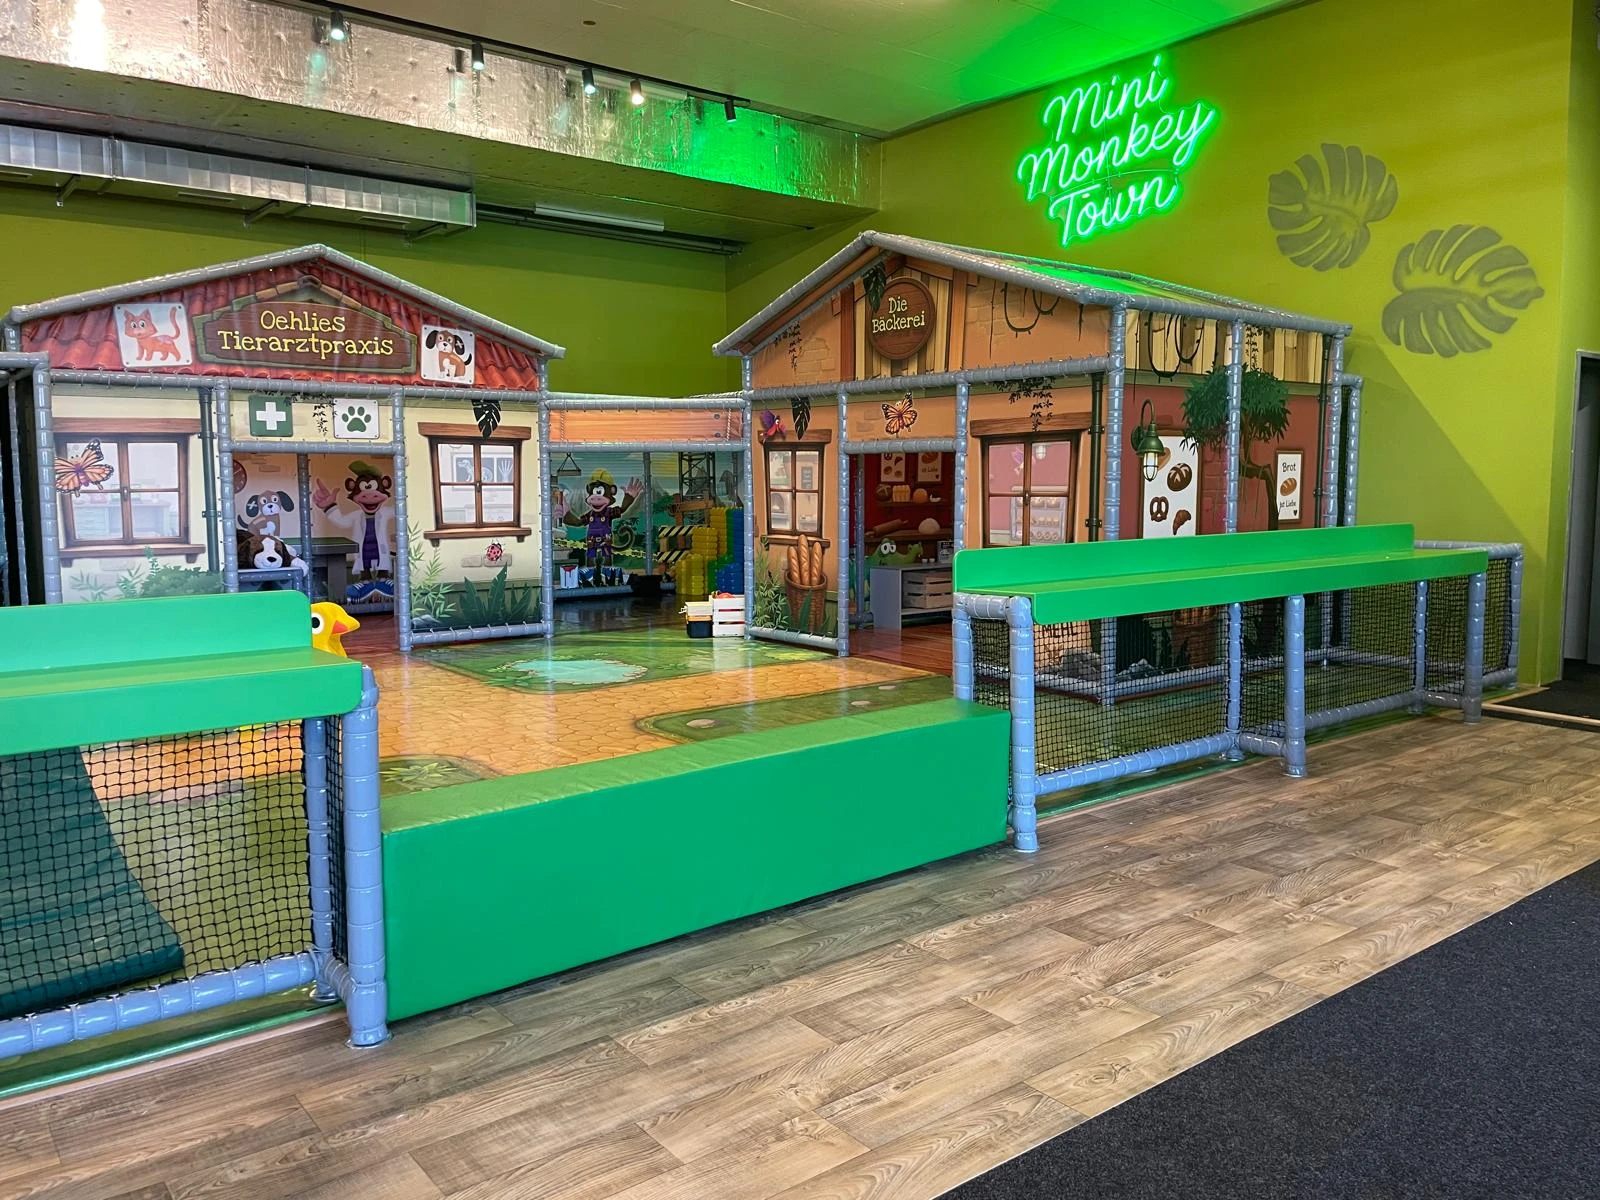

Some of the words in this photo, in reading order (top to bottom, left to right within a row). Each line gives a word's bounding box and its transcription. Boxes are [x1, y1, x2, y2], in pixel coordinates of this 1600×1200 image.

[1043, 54, 1168, 142] Mini
[1017, 103, 1215, 201] Monkey
[1050, 176, 1178, 245] Town
[888, 296, 908, 314] Die
[260, 310, 346, 332] Oehlies
[872, 310, 925, 333] Bäckerei
[217, 330, 394, 360] Tierarztpraxis
[1282, 462, 1296, 472] Brot
[1042, 623, 1079, 638] MEHL
